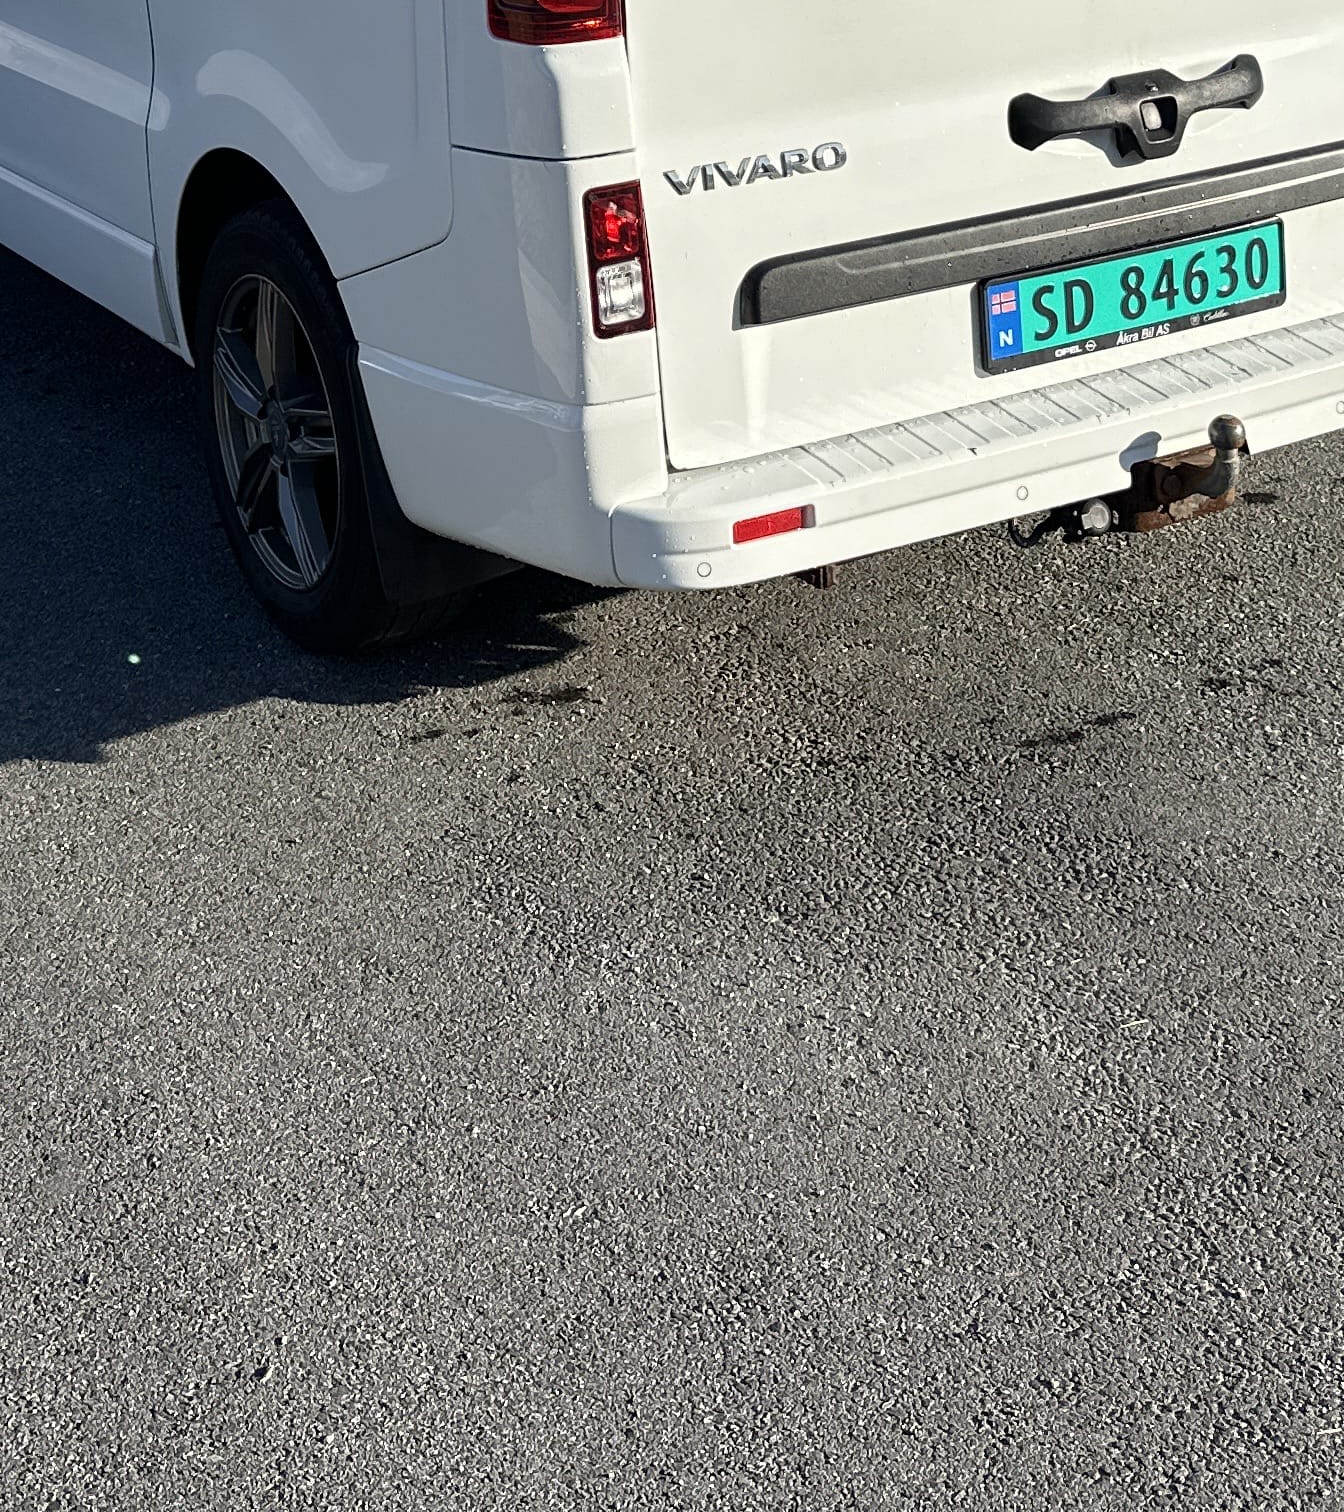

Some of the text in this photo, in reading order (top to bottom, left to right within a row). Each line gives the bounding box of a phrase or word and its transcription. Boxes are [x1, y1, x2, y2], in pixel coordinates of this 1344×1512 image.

[662, 141, 848, 196] VIVARO
[1031, 237, 1269, 342] SD 84630
[999, 329, 1014, 347] N
[1055, 342, 1083, 358] OPEL
[1156, 322, 1171, 337] AS
